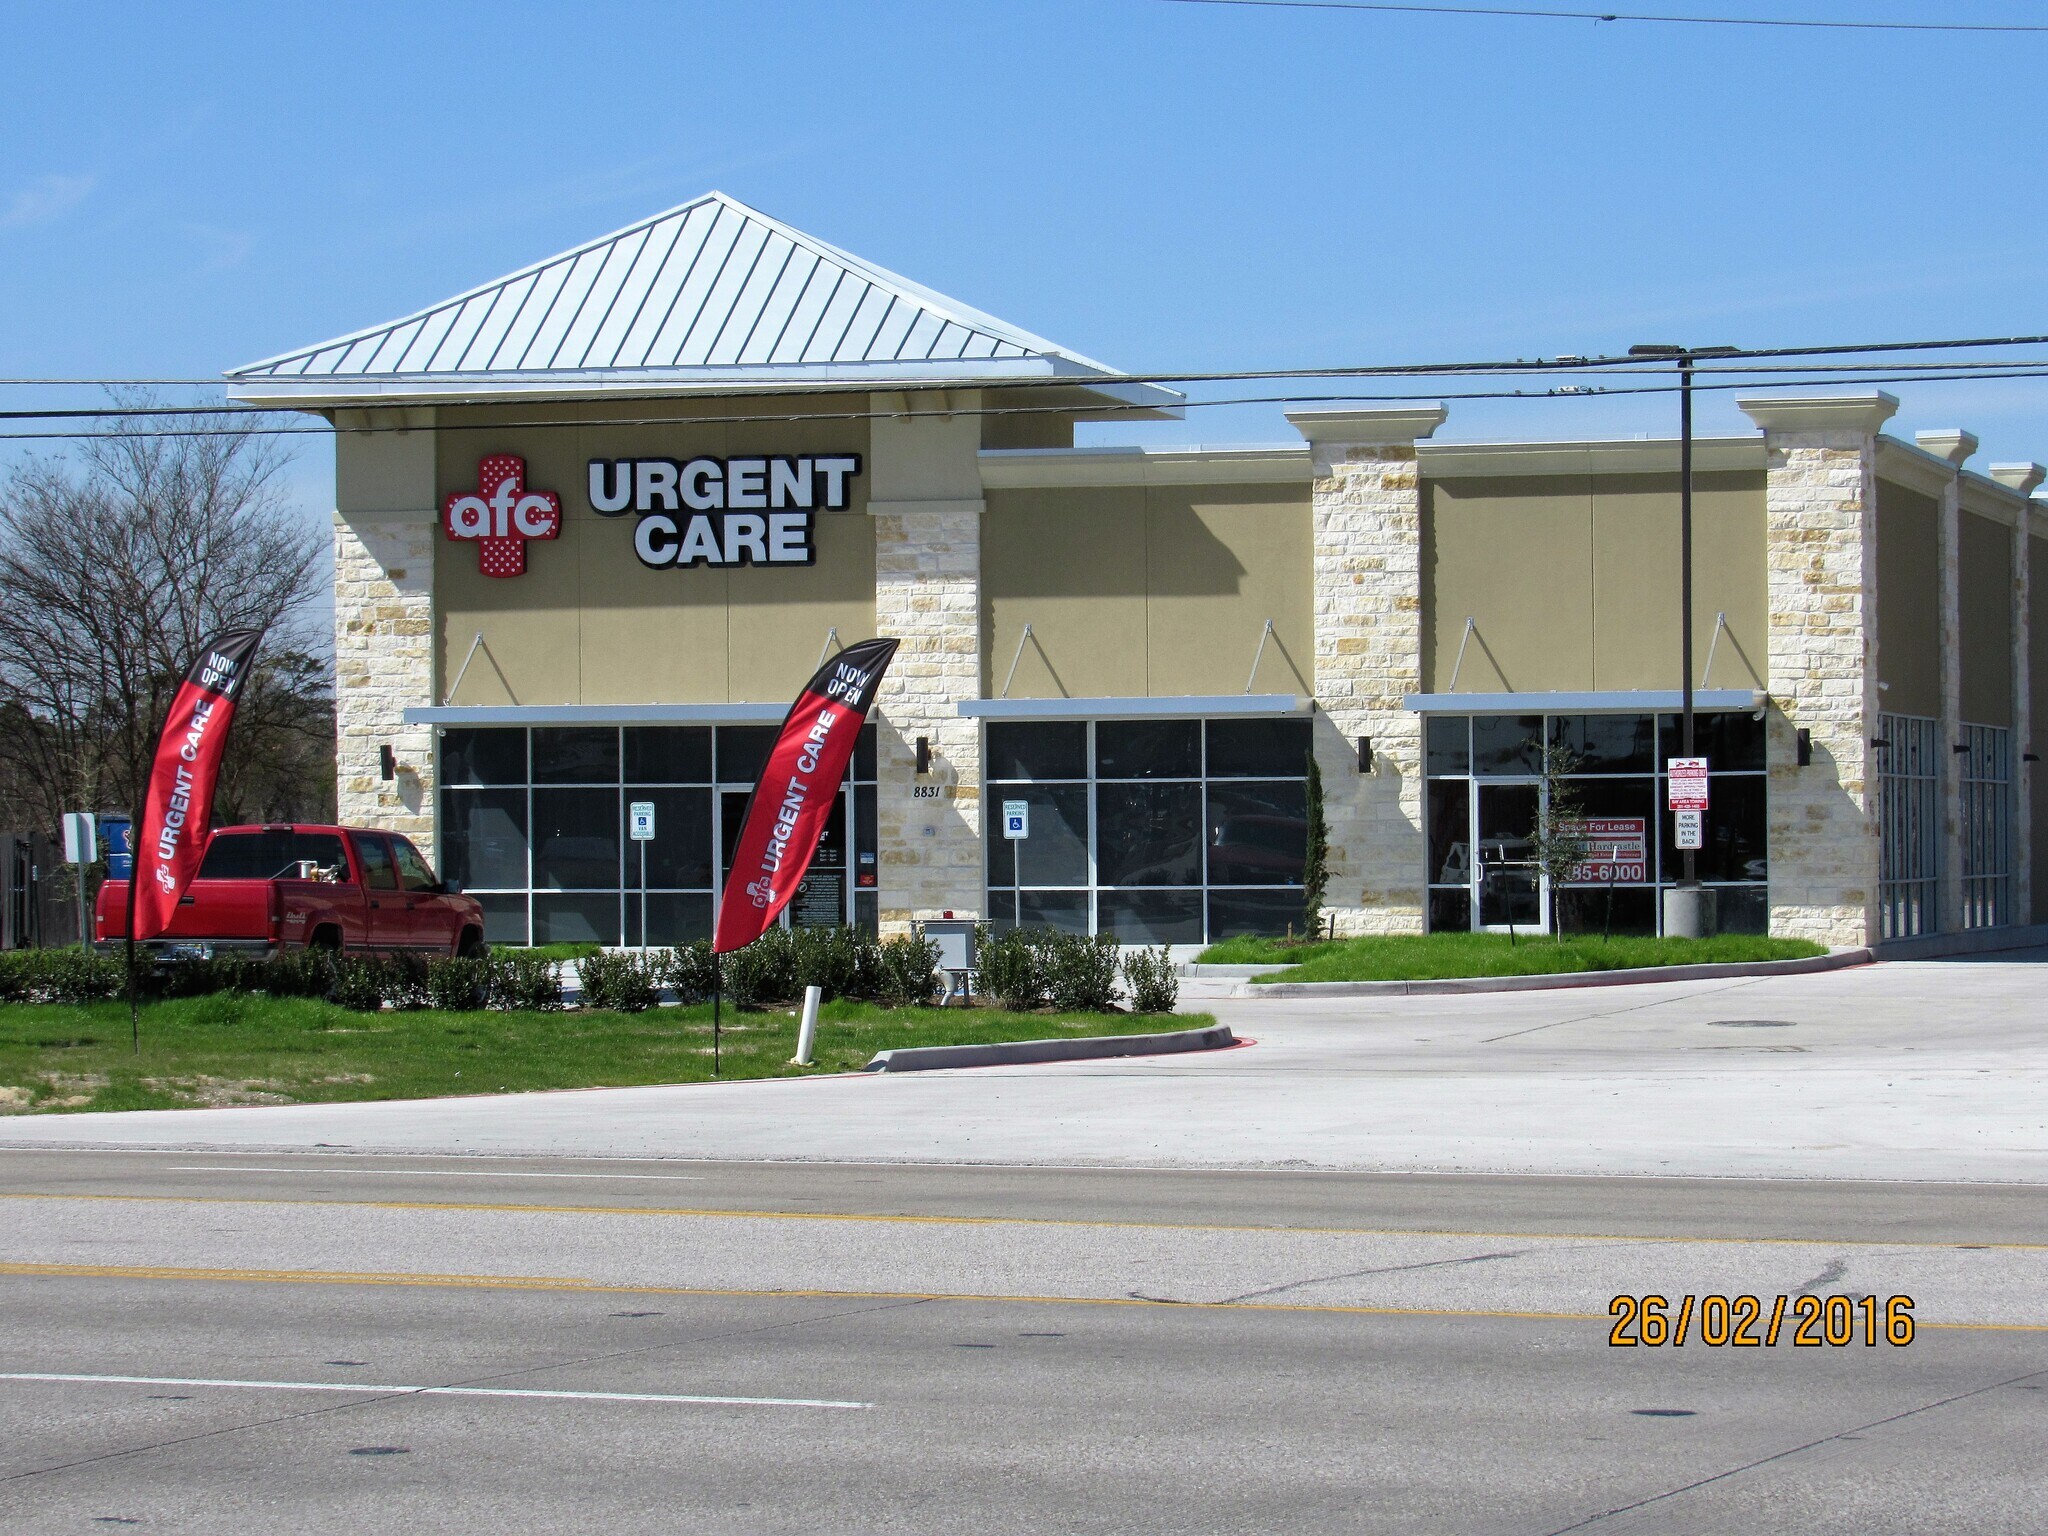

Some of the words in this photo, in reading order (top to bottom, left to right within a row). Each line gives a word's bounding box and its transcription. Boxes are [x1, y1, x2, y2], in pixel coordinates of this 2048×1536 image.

[588, 456, 860, 515] URGENT
[450, 478, 553, 538] afc
[633, 512, 813, 568] CARE
[208, 651, 239, 676] NOW
[835, 662, 871, 688] NOW
[201, 667, 236, 694] OPEN
[827, 678, 863, 706] OPEN
[158, 764, 194, 861] URGENT
[180, 698, 214, 762] CARE
[760, 776, 807, 873] URGENT
[797, 708, 836, 774] CARE
[914, 786, 940, 798] 8831
[1558, 822, 1587, 833] Space
[1589, 822, 1606, 831] For
[1607, 822, 1636, 831] Lease
